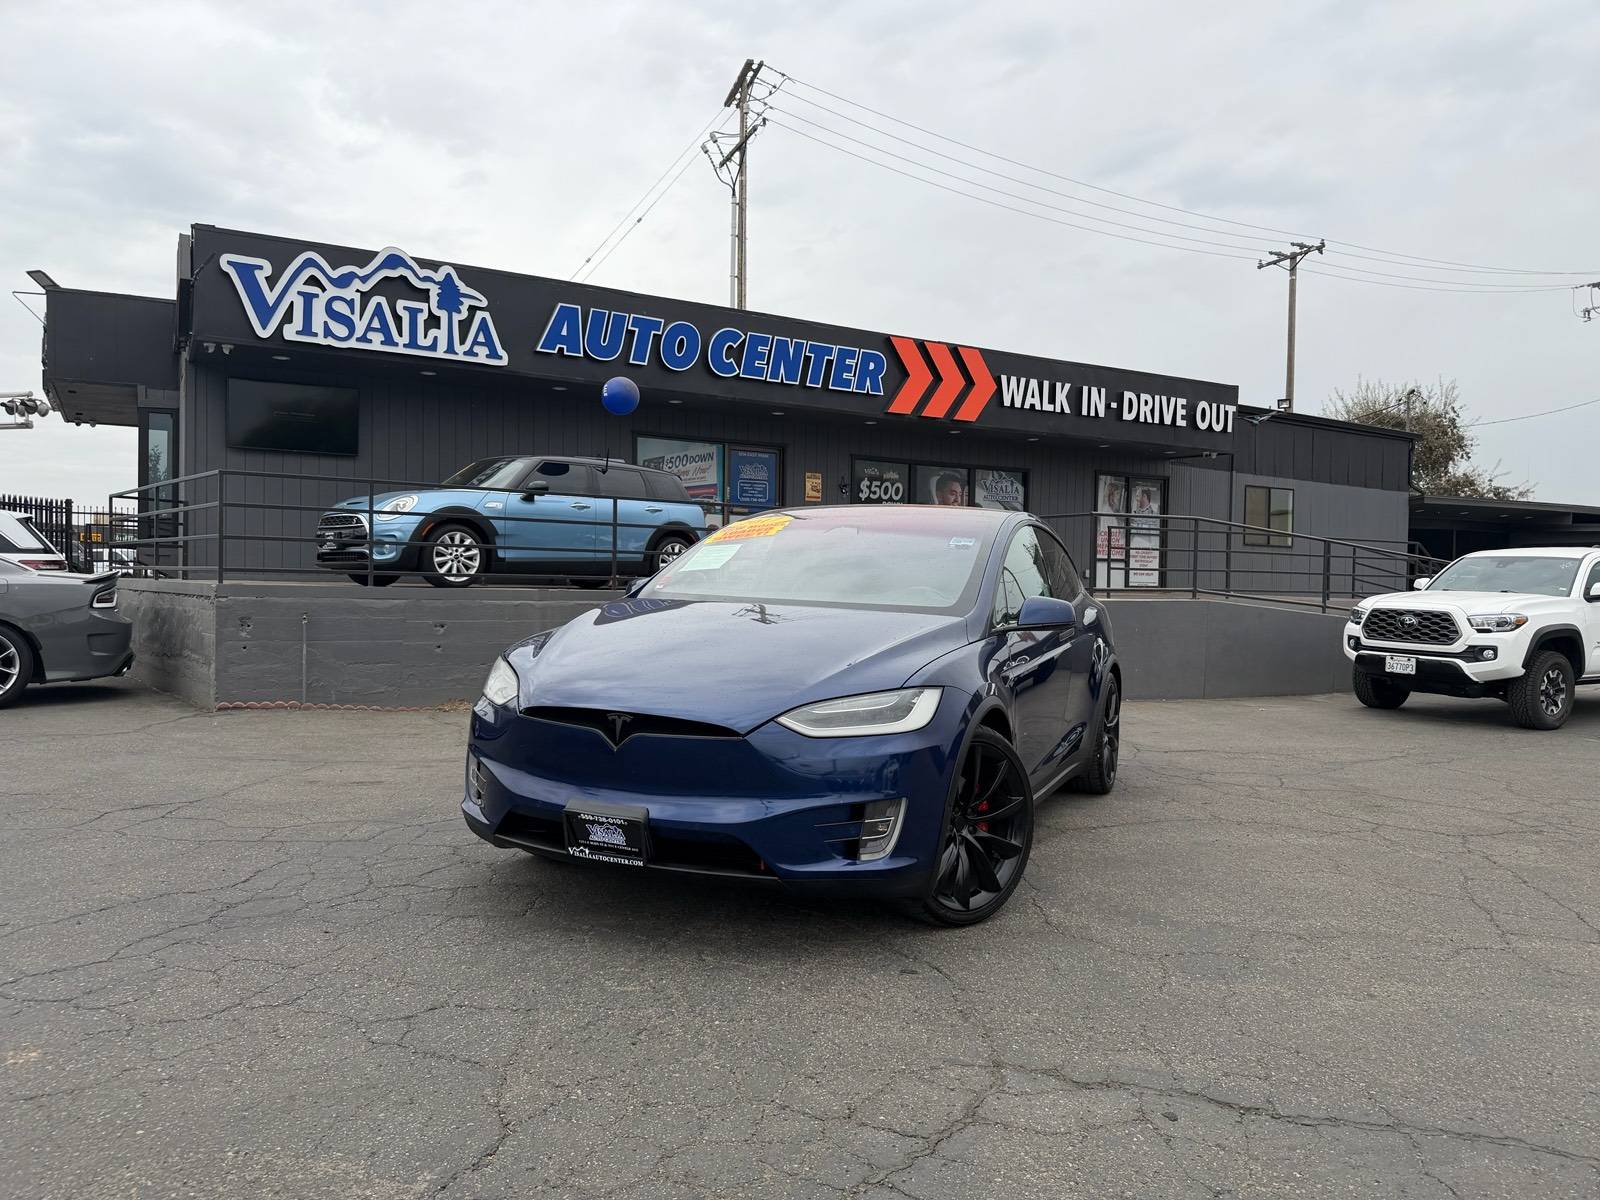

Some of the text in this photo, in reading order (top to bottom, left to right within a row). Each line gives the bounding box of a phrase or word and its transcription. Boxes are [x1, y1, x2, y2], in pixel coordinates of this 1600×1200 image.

[221, 248, 508, 365] VISALIA
[536, 302, 886, 395] AUTO CENTER
[1000, 374, 1071, 414] WALK
[1195, 400, 1237, 433] OUT
[664, 453, 687, 470] $500
[688, 452, 714, 465] DOWN
[859, 477, 904, 501] $500
[980, 479, 1020, 495] VISALIA
